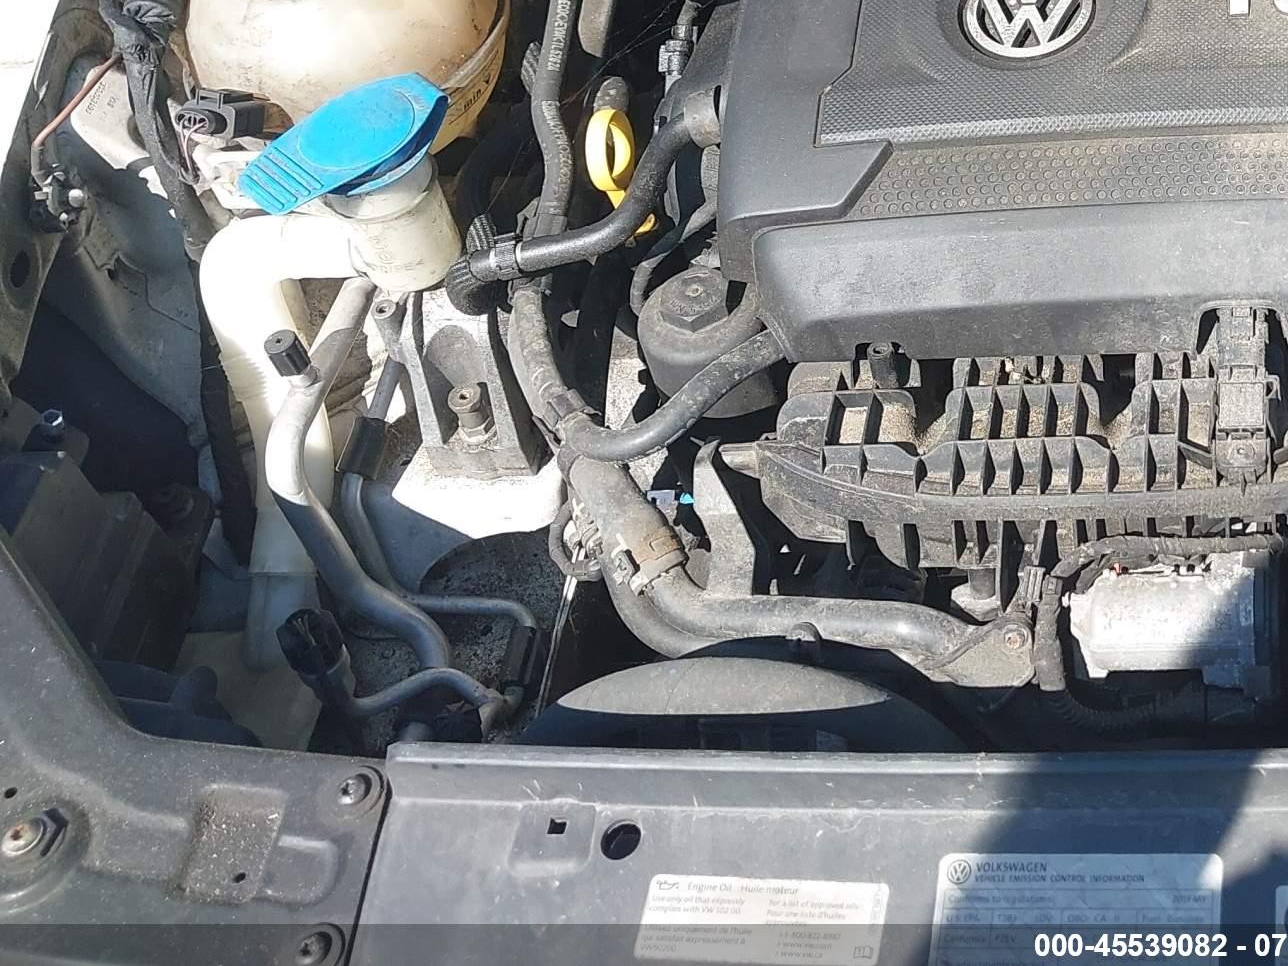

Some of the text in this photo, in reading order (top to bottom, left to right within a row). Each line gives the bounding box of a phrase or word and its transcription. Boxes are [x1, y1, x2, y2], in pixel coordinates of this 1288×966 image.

[463, 88, 482, 111] min
[976, 862, 1048, 873] VOLKSWAGEN
[975, 874, 1145, 883] VEHICLE EMISSION CONTROL INFORMATION
[688, 882, 732, 894] Engine Oil
[740, 884, 799, 895] Huile moteur
